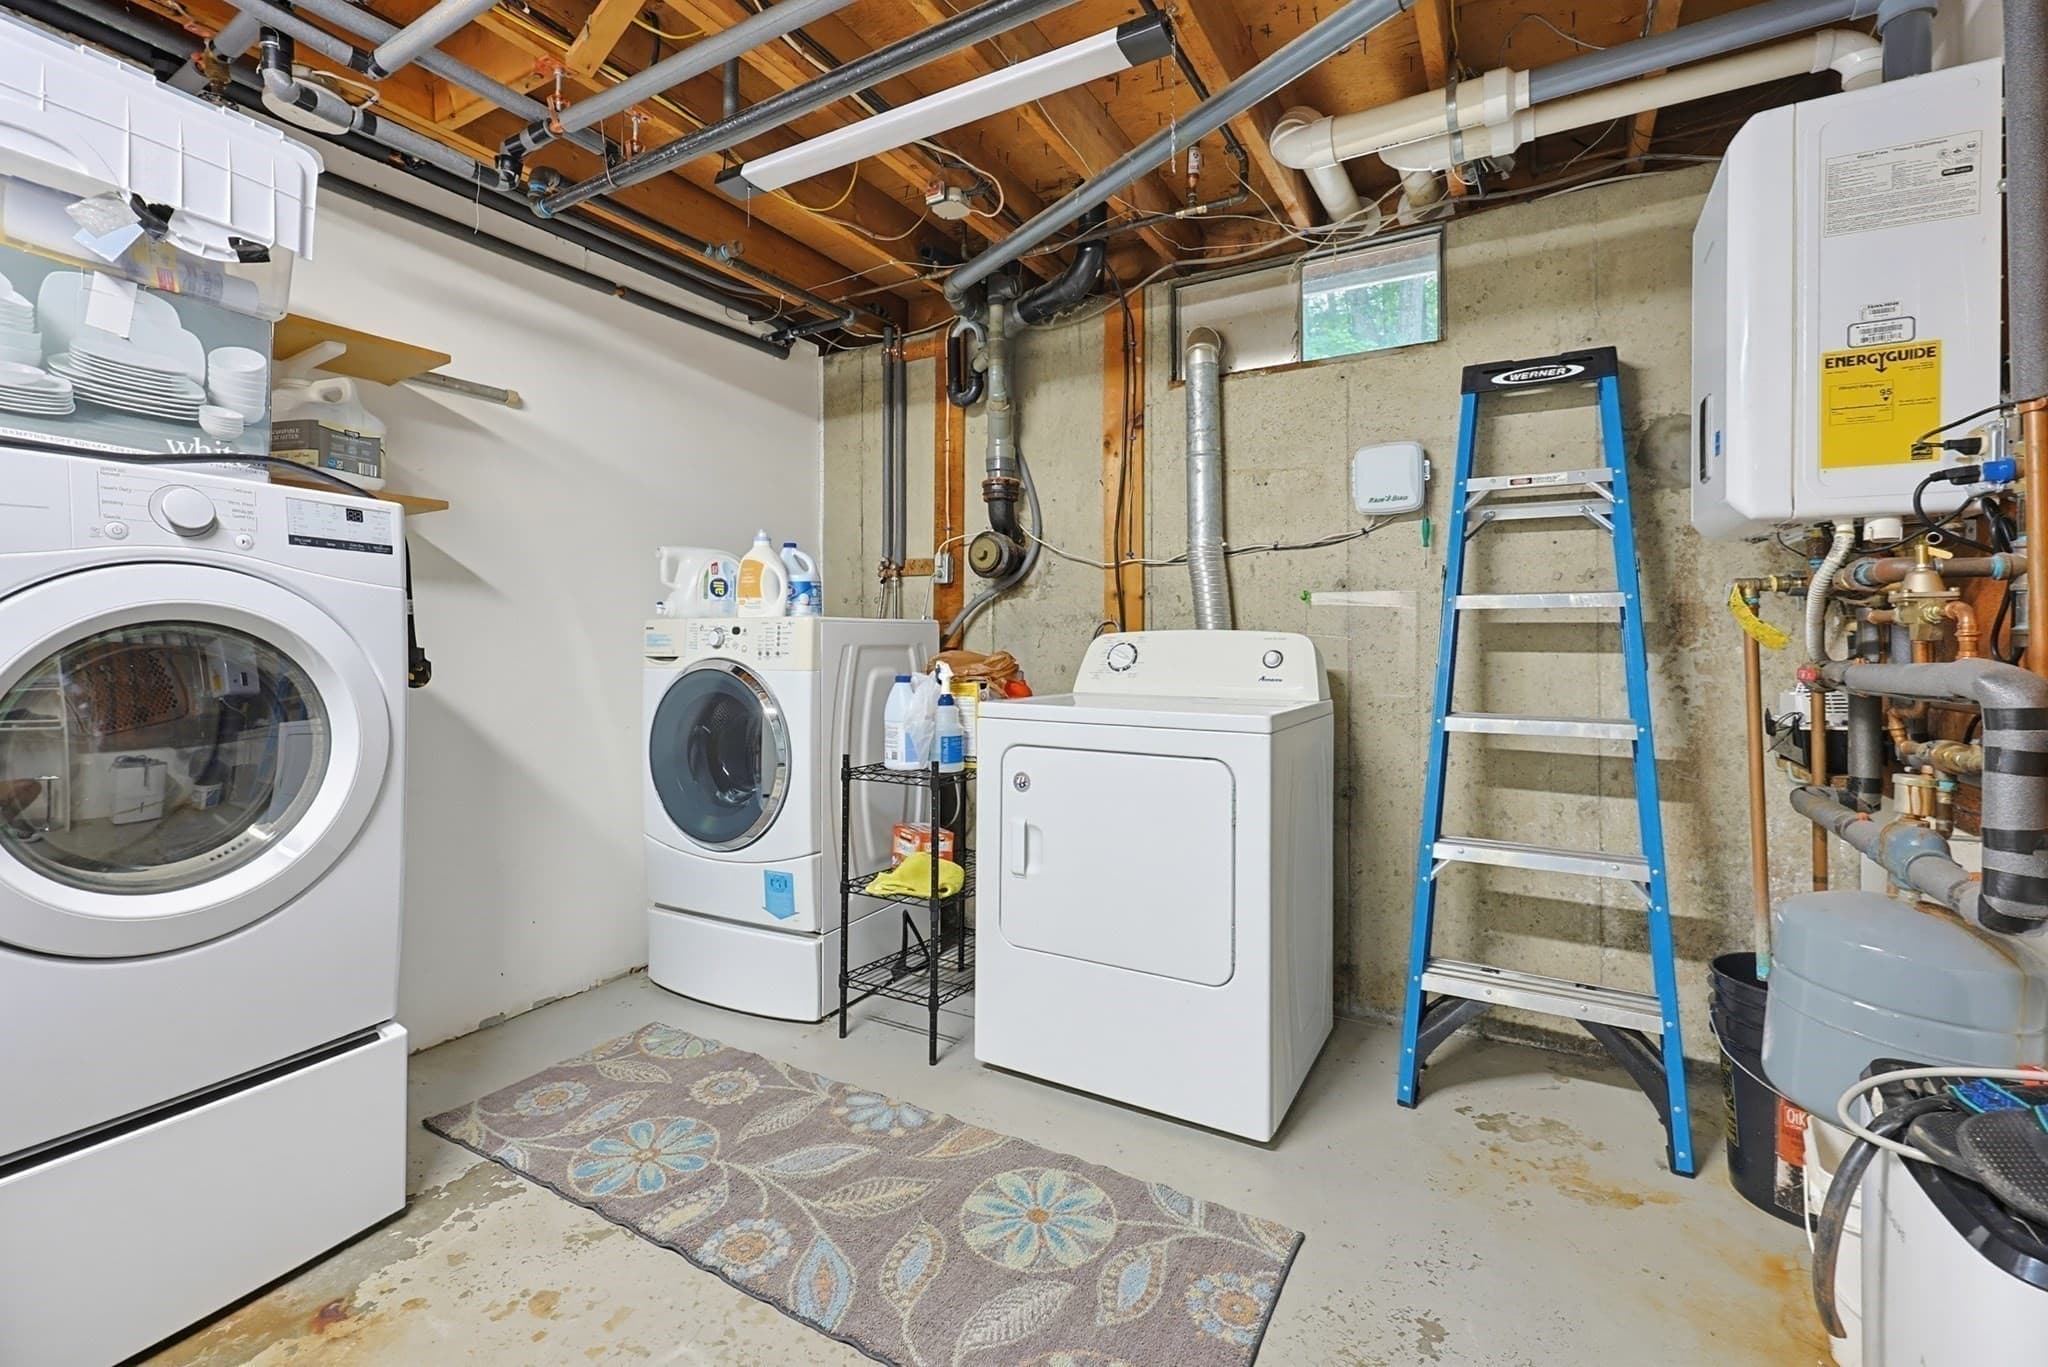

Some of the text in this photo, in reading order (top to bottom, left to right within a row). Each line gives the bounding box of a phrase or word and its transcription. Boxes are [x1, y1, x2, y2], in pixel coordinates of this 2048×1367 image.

[1509, 367, 1567, 381] WERNER
[1879, 388, 1893, 396] 95
[714, 582, 724, 596] all
